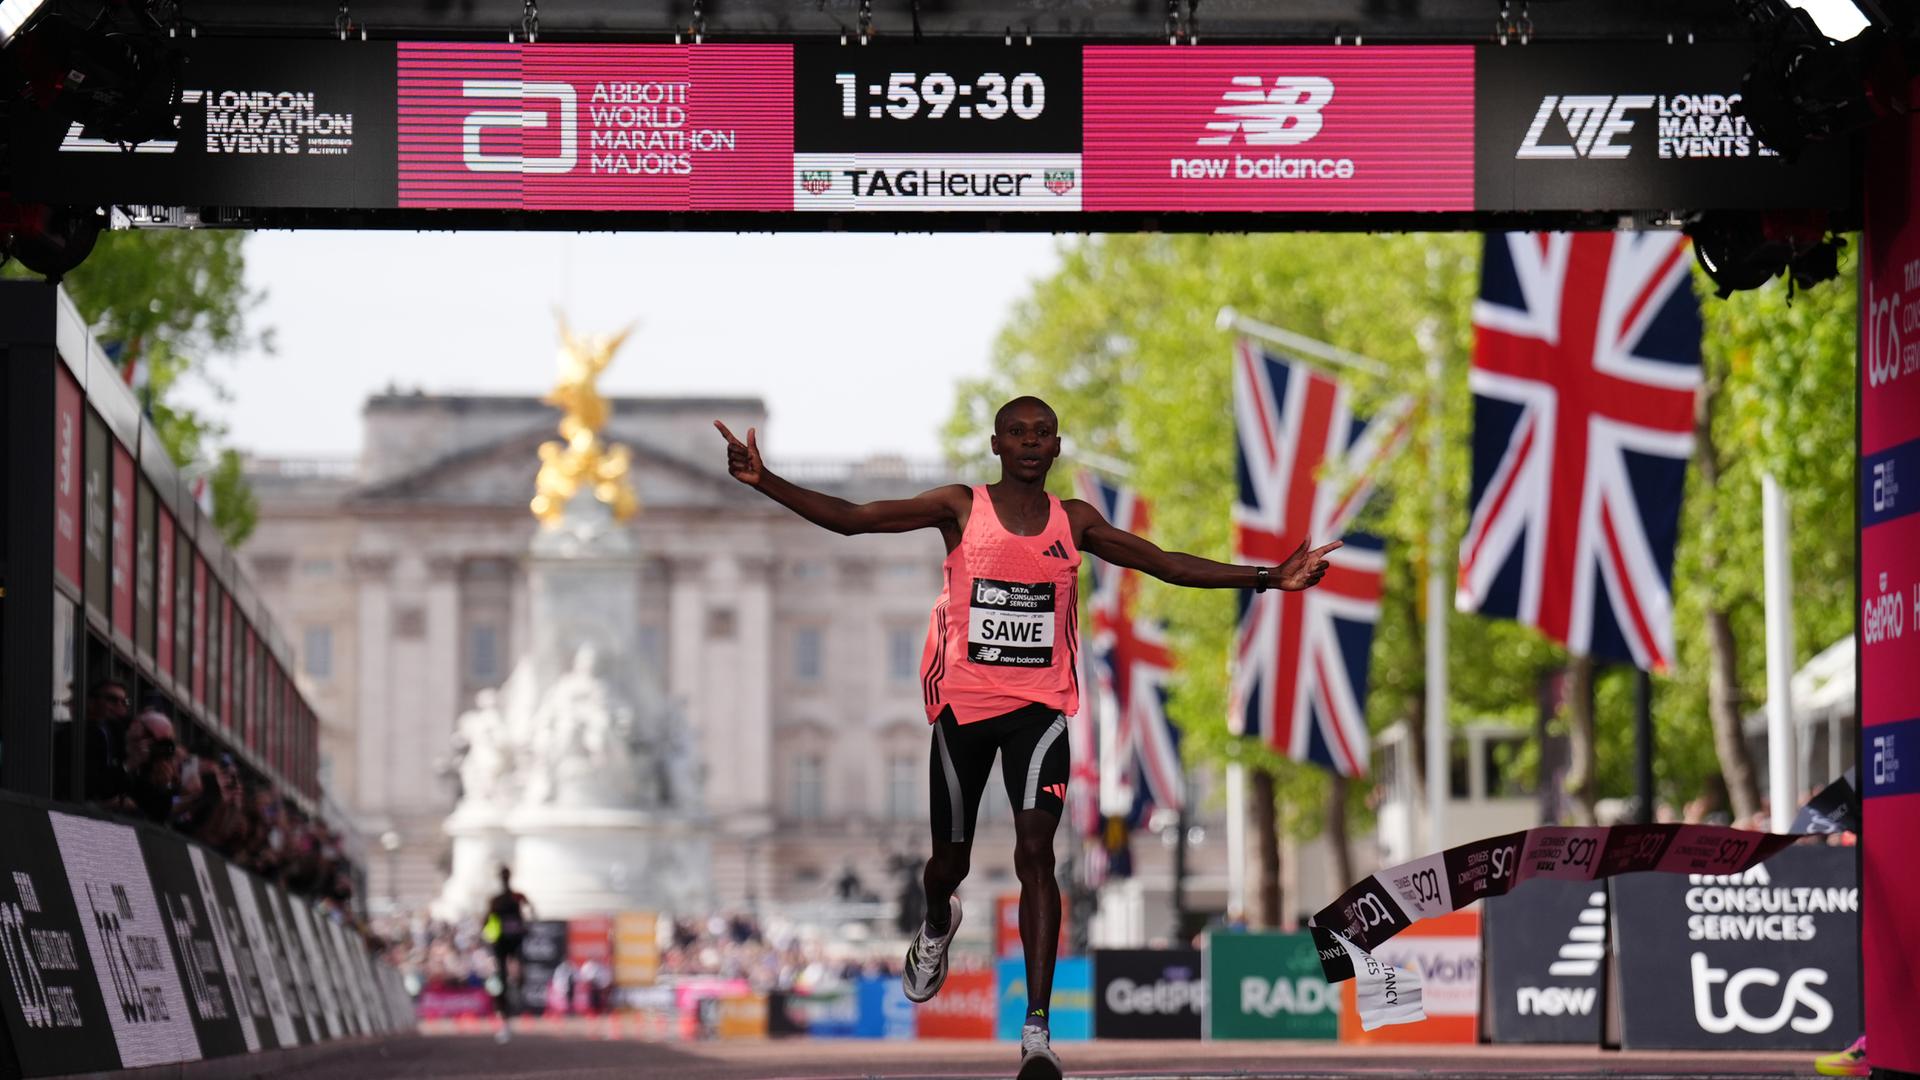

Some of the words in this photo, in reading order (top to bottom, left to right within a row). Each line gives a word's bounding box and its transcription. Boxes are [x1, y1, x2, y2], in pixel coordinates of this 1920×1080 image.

[206, 90, 314, 112] LONDON
[590, 81, 692, 104] ABBOTT
[835, 72, 1046, 120] 1:59:30
[206, 111, 353, 135] MARATHON
[589, 105, 686, 128] WORLD
[206, 133, 300, 154] EVENTS
[590, 129, 736, 152] MARATHON
[1658, 136, 1751, 158] EVENTS
[590, 152, 692, 175] MAJORS
[1170, 158, 1230, 179] new
[1235, 152, 1355, 179] balance
[1869, 280, 1900, 388] tcs
[976, 583, 1009, 605] tcs
[1009, 593, 1051, 601] CONSULTANCY
[1010, 586, 1030, 594] TATA
[1009, 600, 1038, 608] SERVICES
[981, 618, 1043, 643] SAWE
[1000, 655, 1016, 663] new
[1016, 655, 1046, 664] balance
[1562, 837, 1598, 873] tcs
[1411, 867, 1442, 906] tcs
[1352, 891, 1396, 933] tcs
[1687, 914, 1817, 941] SERVICES
[1516, 986, 1597, 1017] new
[1690, 950, 1834, 1034] tcs
